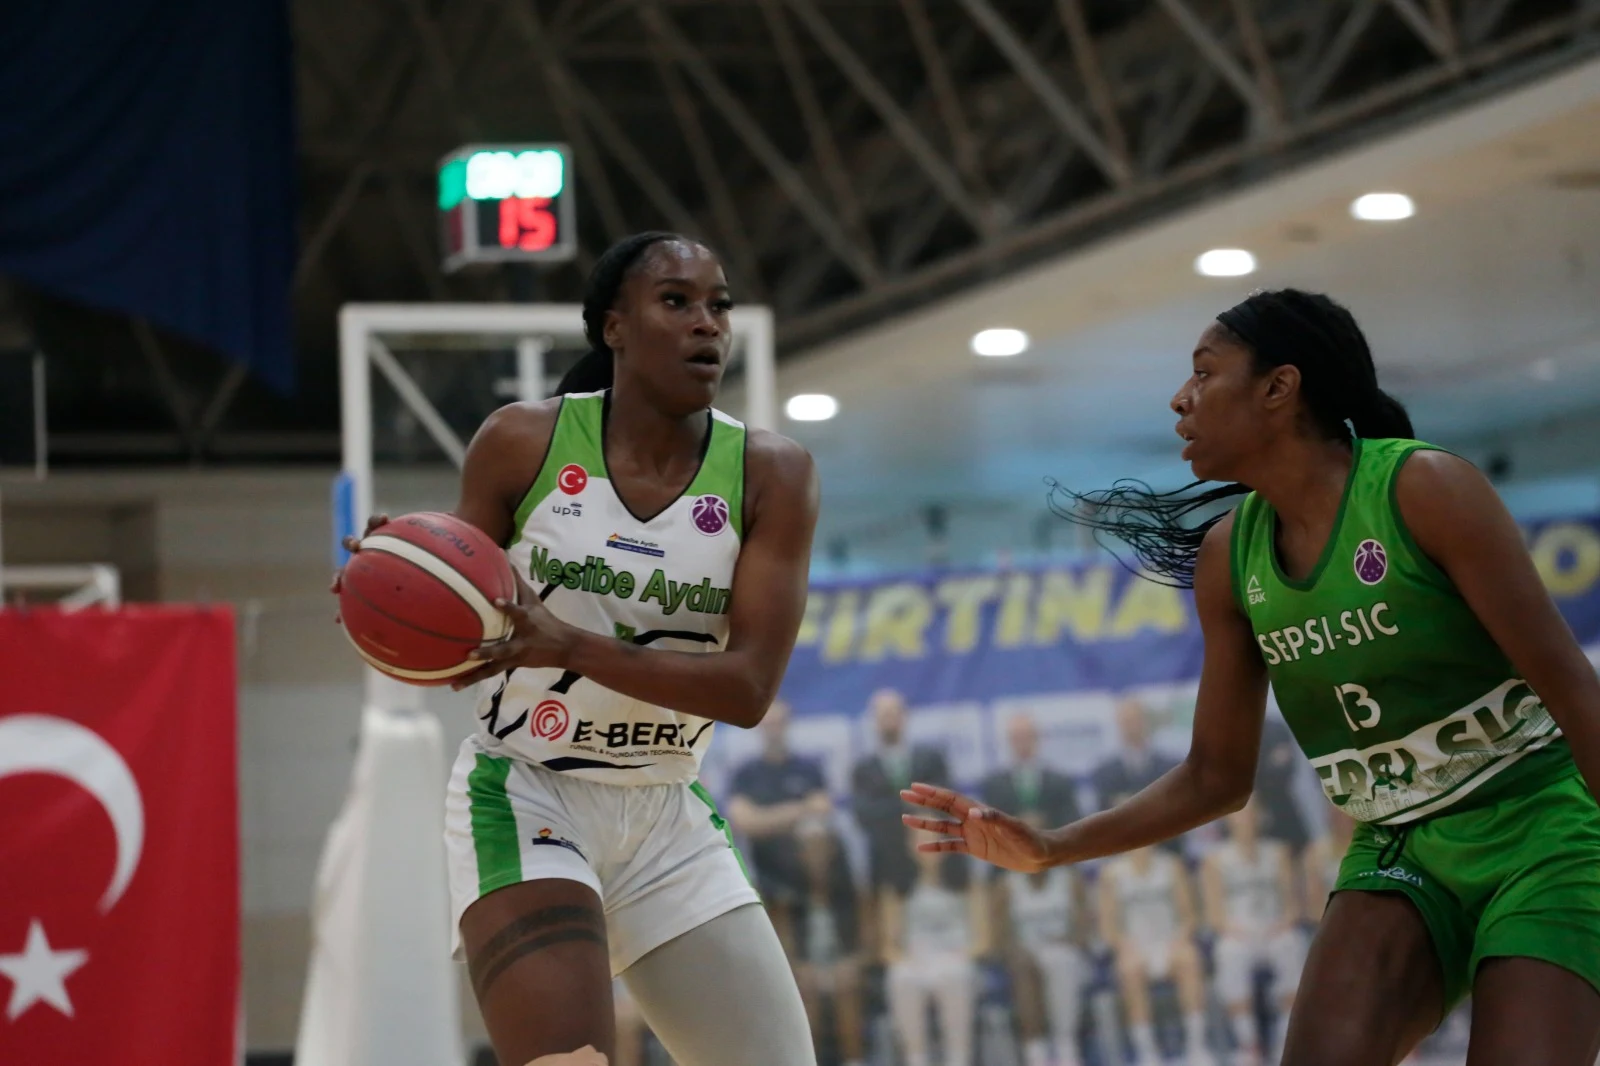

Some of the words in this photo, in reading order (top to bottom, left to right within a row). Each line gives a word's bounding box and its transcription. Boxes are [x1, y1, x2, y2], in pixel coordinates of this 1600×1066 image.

[498, 195, 557, 252] 15
[552, 505, 581, 517] upa
[529, 545, 635, 599] Nesibe
[1257, 602, 1399, 665] SEPSI-SIC
[1333, 682, 1382, 732] 13
[650, 749, 694, 757] TECHNOLOG
